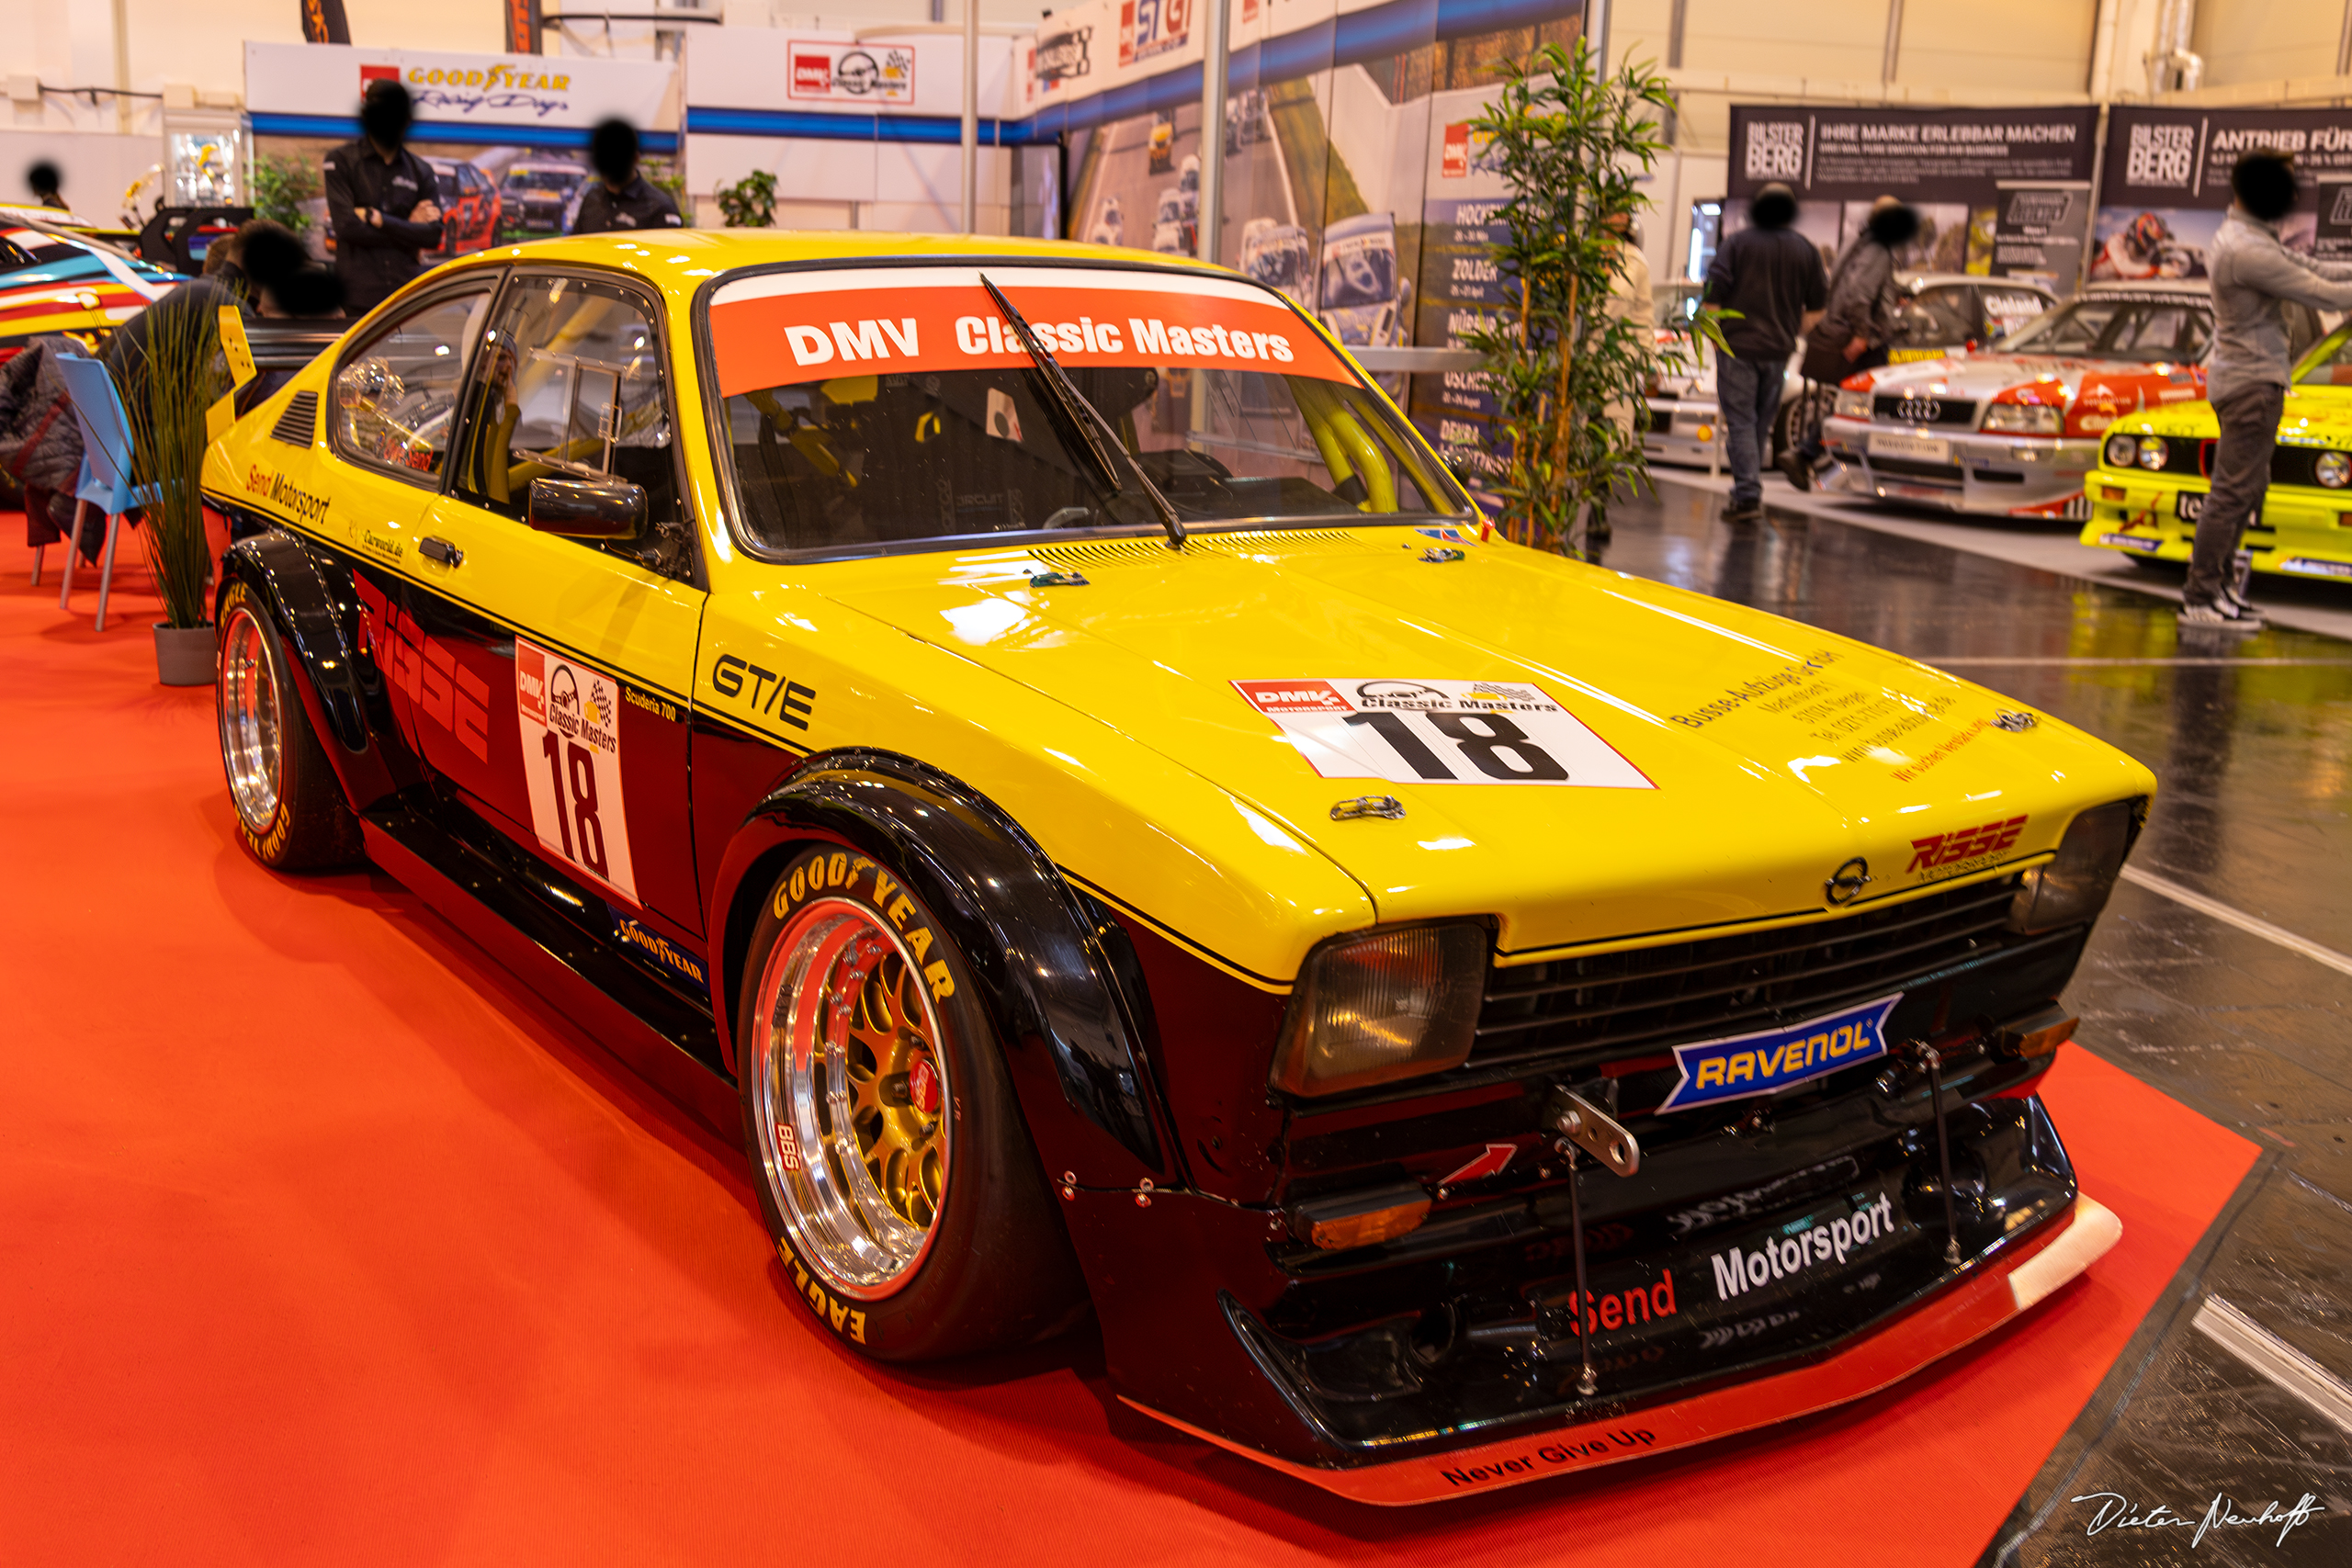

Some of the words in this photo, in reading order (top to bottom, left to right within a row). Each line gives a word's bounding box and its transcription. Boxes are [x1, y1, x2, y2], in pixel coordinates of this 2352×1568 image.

[1747, 121, 1804, 145] BILSTER
[1820, 122, 1860, 141] IHRE
[1860, 123, 1920, 142] MARKE
[1921, 124, 2005, 142] ERLEBBAR
[2006, 123, 2076, 143] MACHEN
[2131, 123, 2194, 148] BILSTER
[2211, 129, 2308, 152] ANTRIEB
[1746, 142, 1804, 174] BERG
[2127, 146, 2192, 181] BERG
[783, 316, 920, 367] DMV
[956, 315, 1125, 355] Classic
[1128, 317, 1295, 364] Masters
[245, 463, 275, 498] Send
[269, 472, 332, 525] Motorsport
[519, 670, 544, 699] DMV
[625, 685, 660, 716] Scuderia
[660, 702, 677, 722] 700
[712, 653, 817, 732] GT/E
[1361, 696, 1453, 710] Classic
[1460, 697, 1559, 713] Masters
[549, 704, 580, 736] Classic
[581, 718, 616, 754] Masters
[1340, 712, 1569, 781] 18
[542, 730, 610, 883] 18
[618, 918, 705, 984] GOODYEAR
[773, 852, 956, 1005] GOODYEAR
[1696, 1021, 1871, 1089] RAVENOL
[778, 1123, 800, 1171] BBS
[1568, 1268, 1679, 1338] Send
[1710, 1190, 1896, 1302] Motorsport
[1440, 1454, 1535, 1487] Never
[1537, 1439, 1611, 1464] Give
[1605, 1427, 1657, 1448] Up
